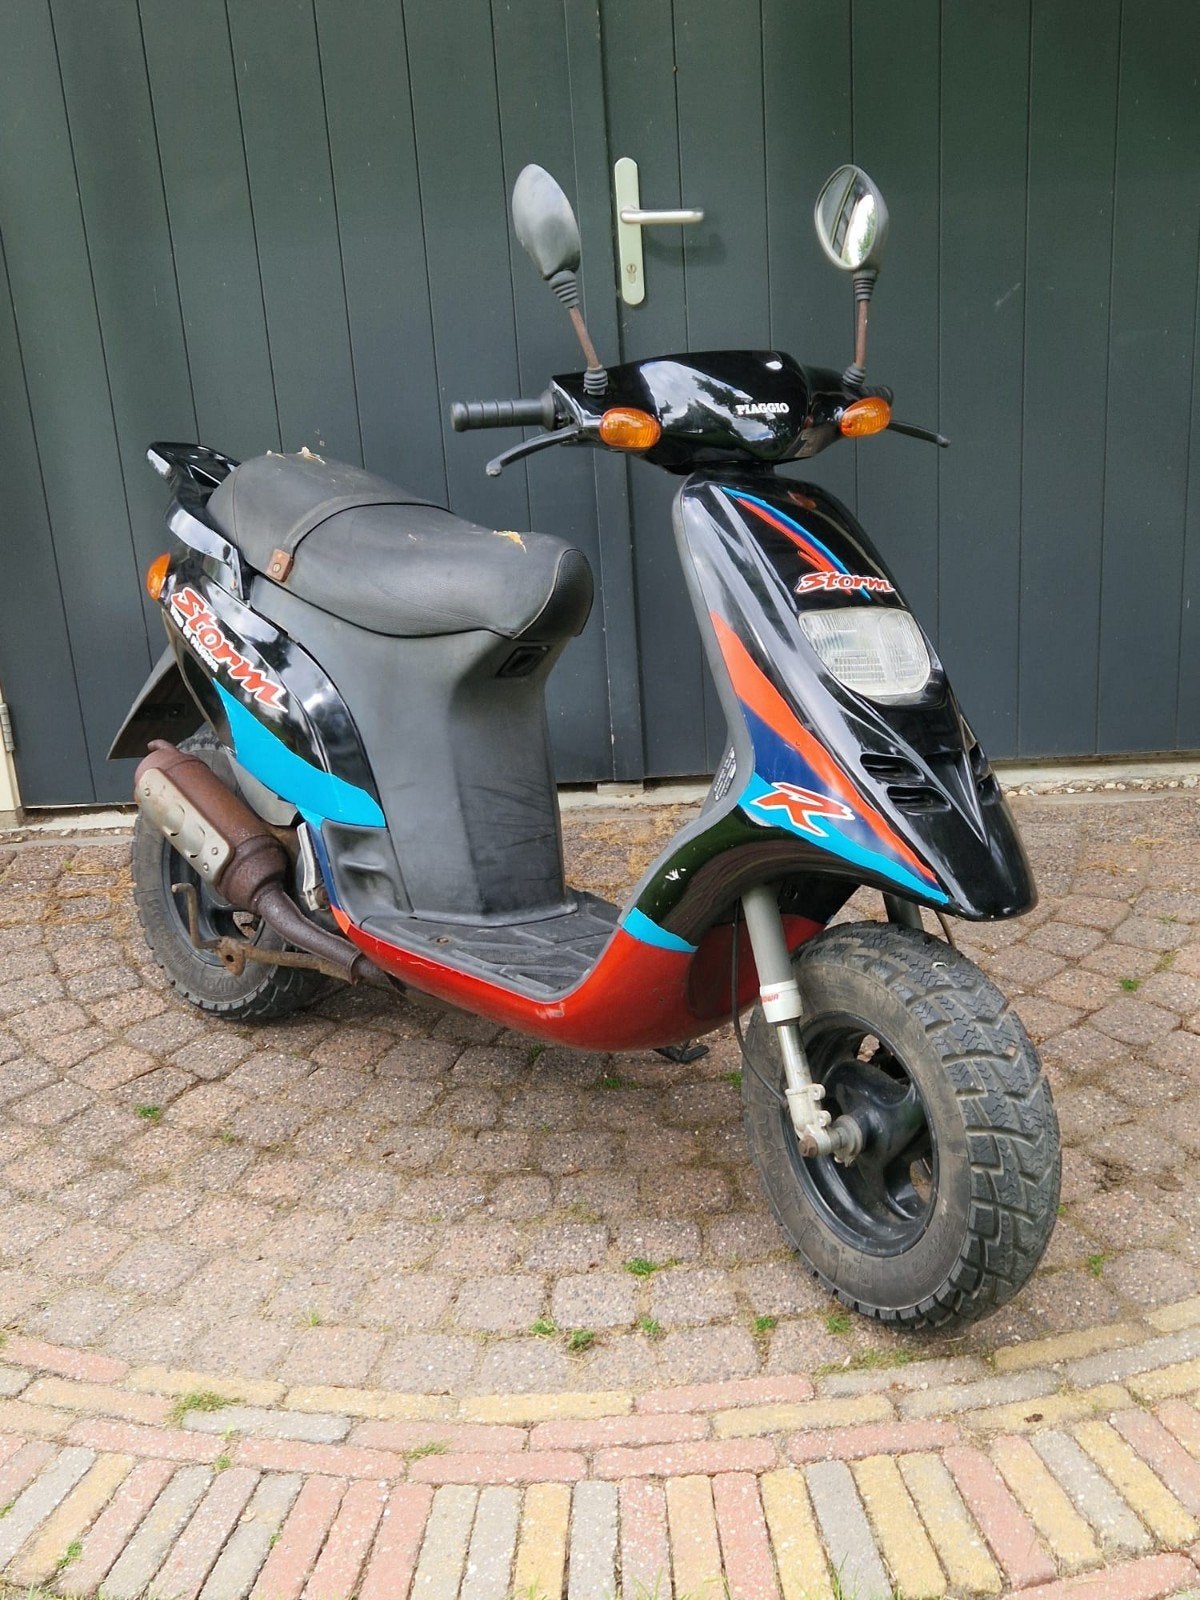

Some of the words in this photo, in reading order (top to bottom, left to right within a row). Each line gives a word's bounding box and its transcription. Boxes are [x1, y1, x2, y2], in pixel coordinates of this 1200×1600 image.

[735, 402, 790, 415] PIAGGIO
[795, 571, 896, 592] Storm
[170, 587, 288, 712] Storm
[750, 782, 855, 837] R
